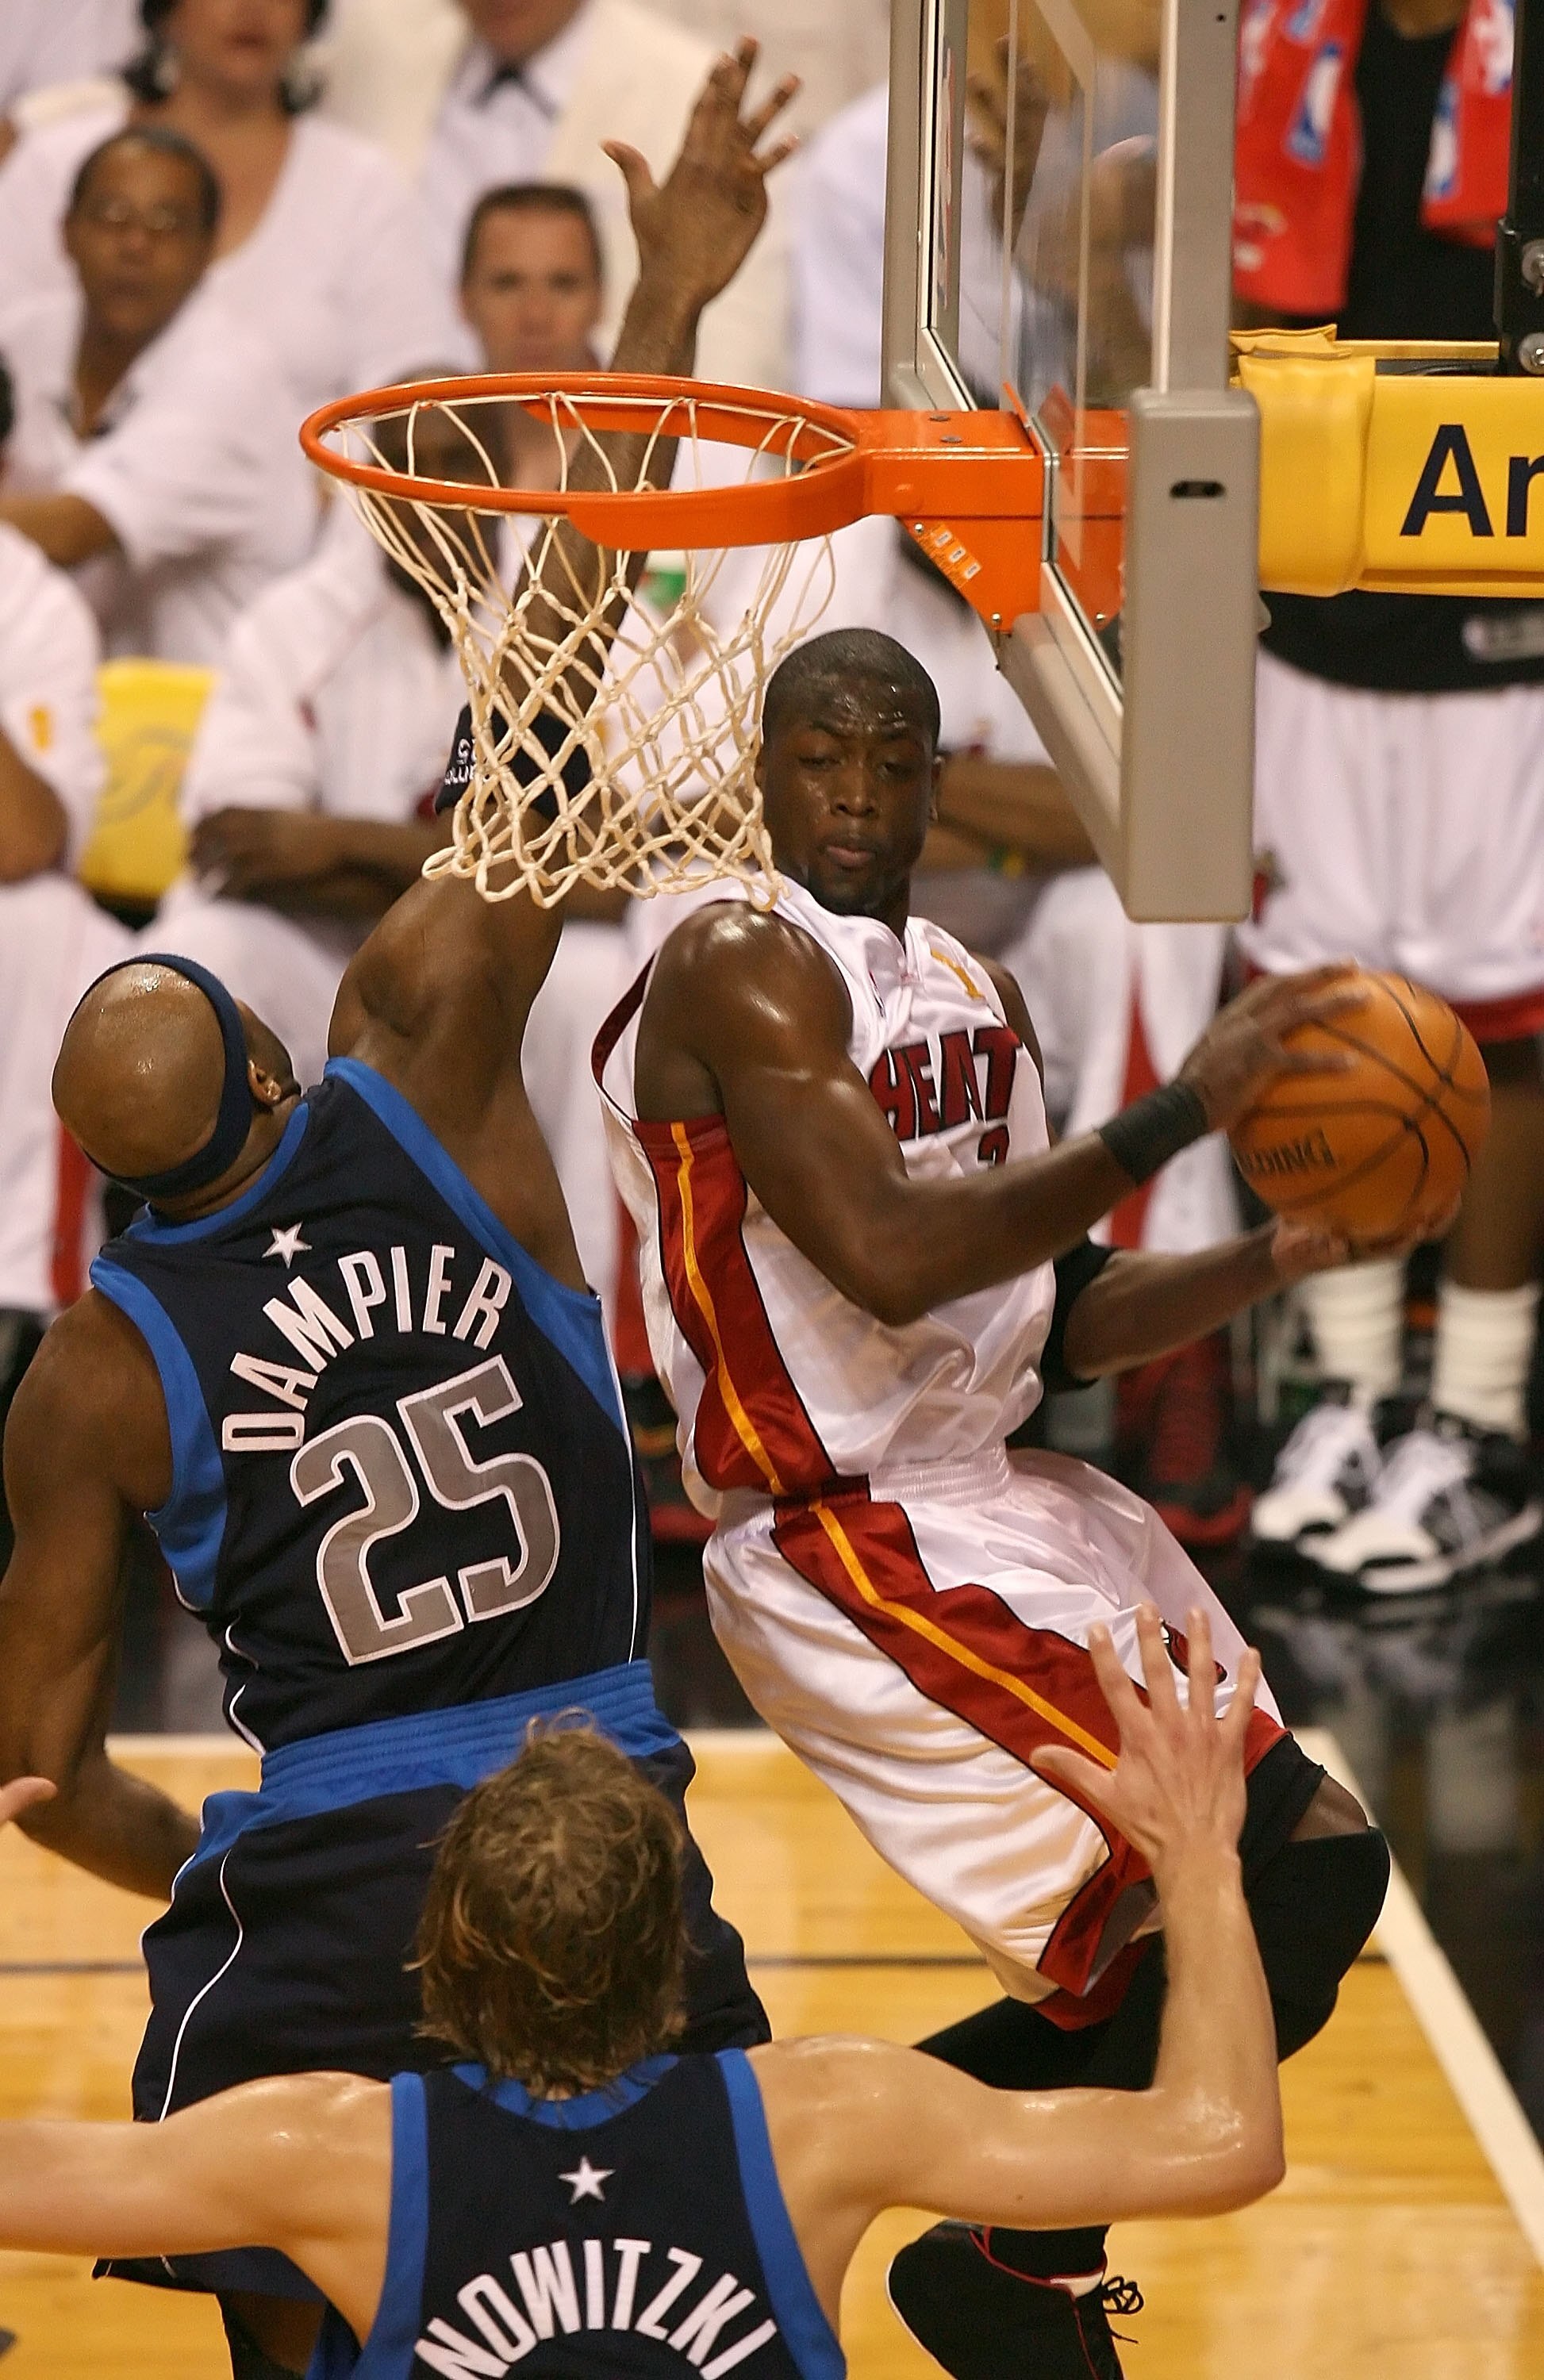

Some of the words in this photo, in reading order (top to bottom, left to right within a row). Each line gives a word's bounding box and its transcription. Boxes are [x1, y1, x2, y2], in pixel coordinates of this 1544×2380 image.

[869, 1025, 1023, 1141] HEAT
[222, 1244, 513, 1451] DAMPIER
[290, 1353, 560, 1666] 25
[413, 2238, 778, 2380] NOWITZKI
